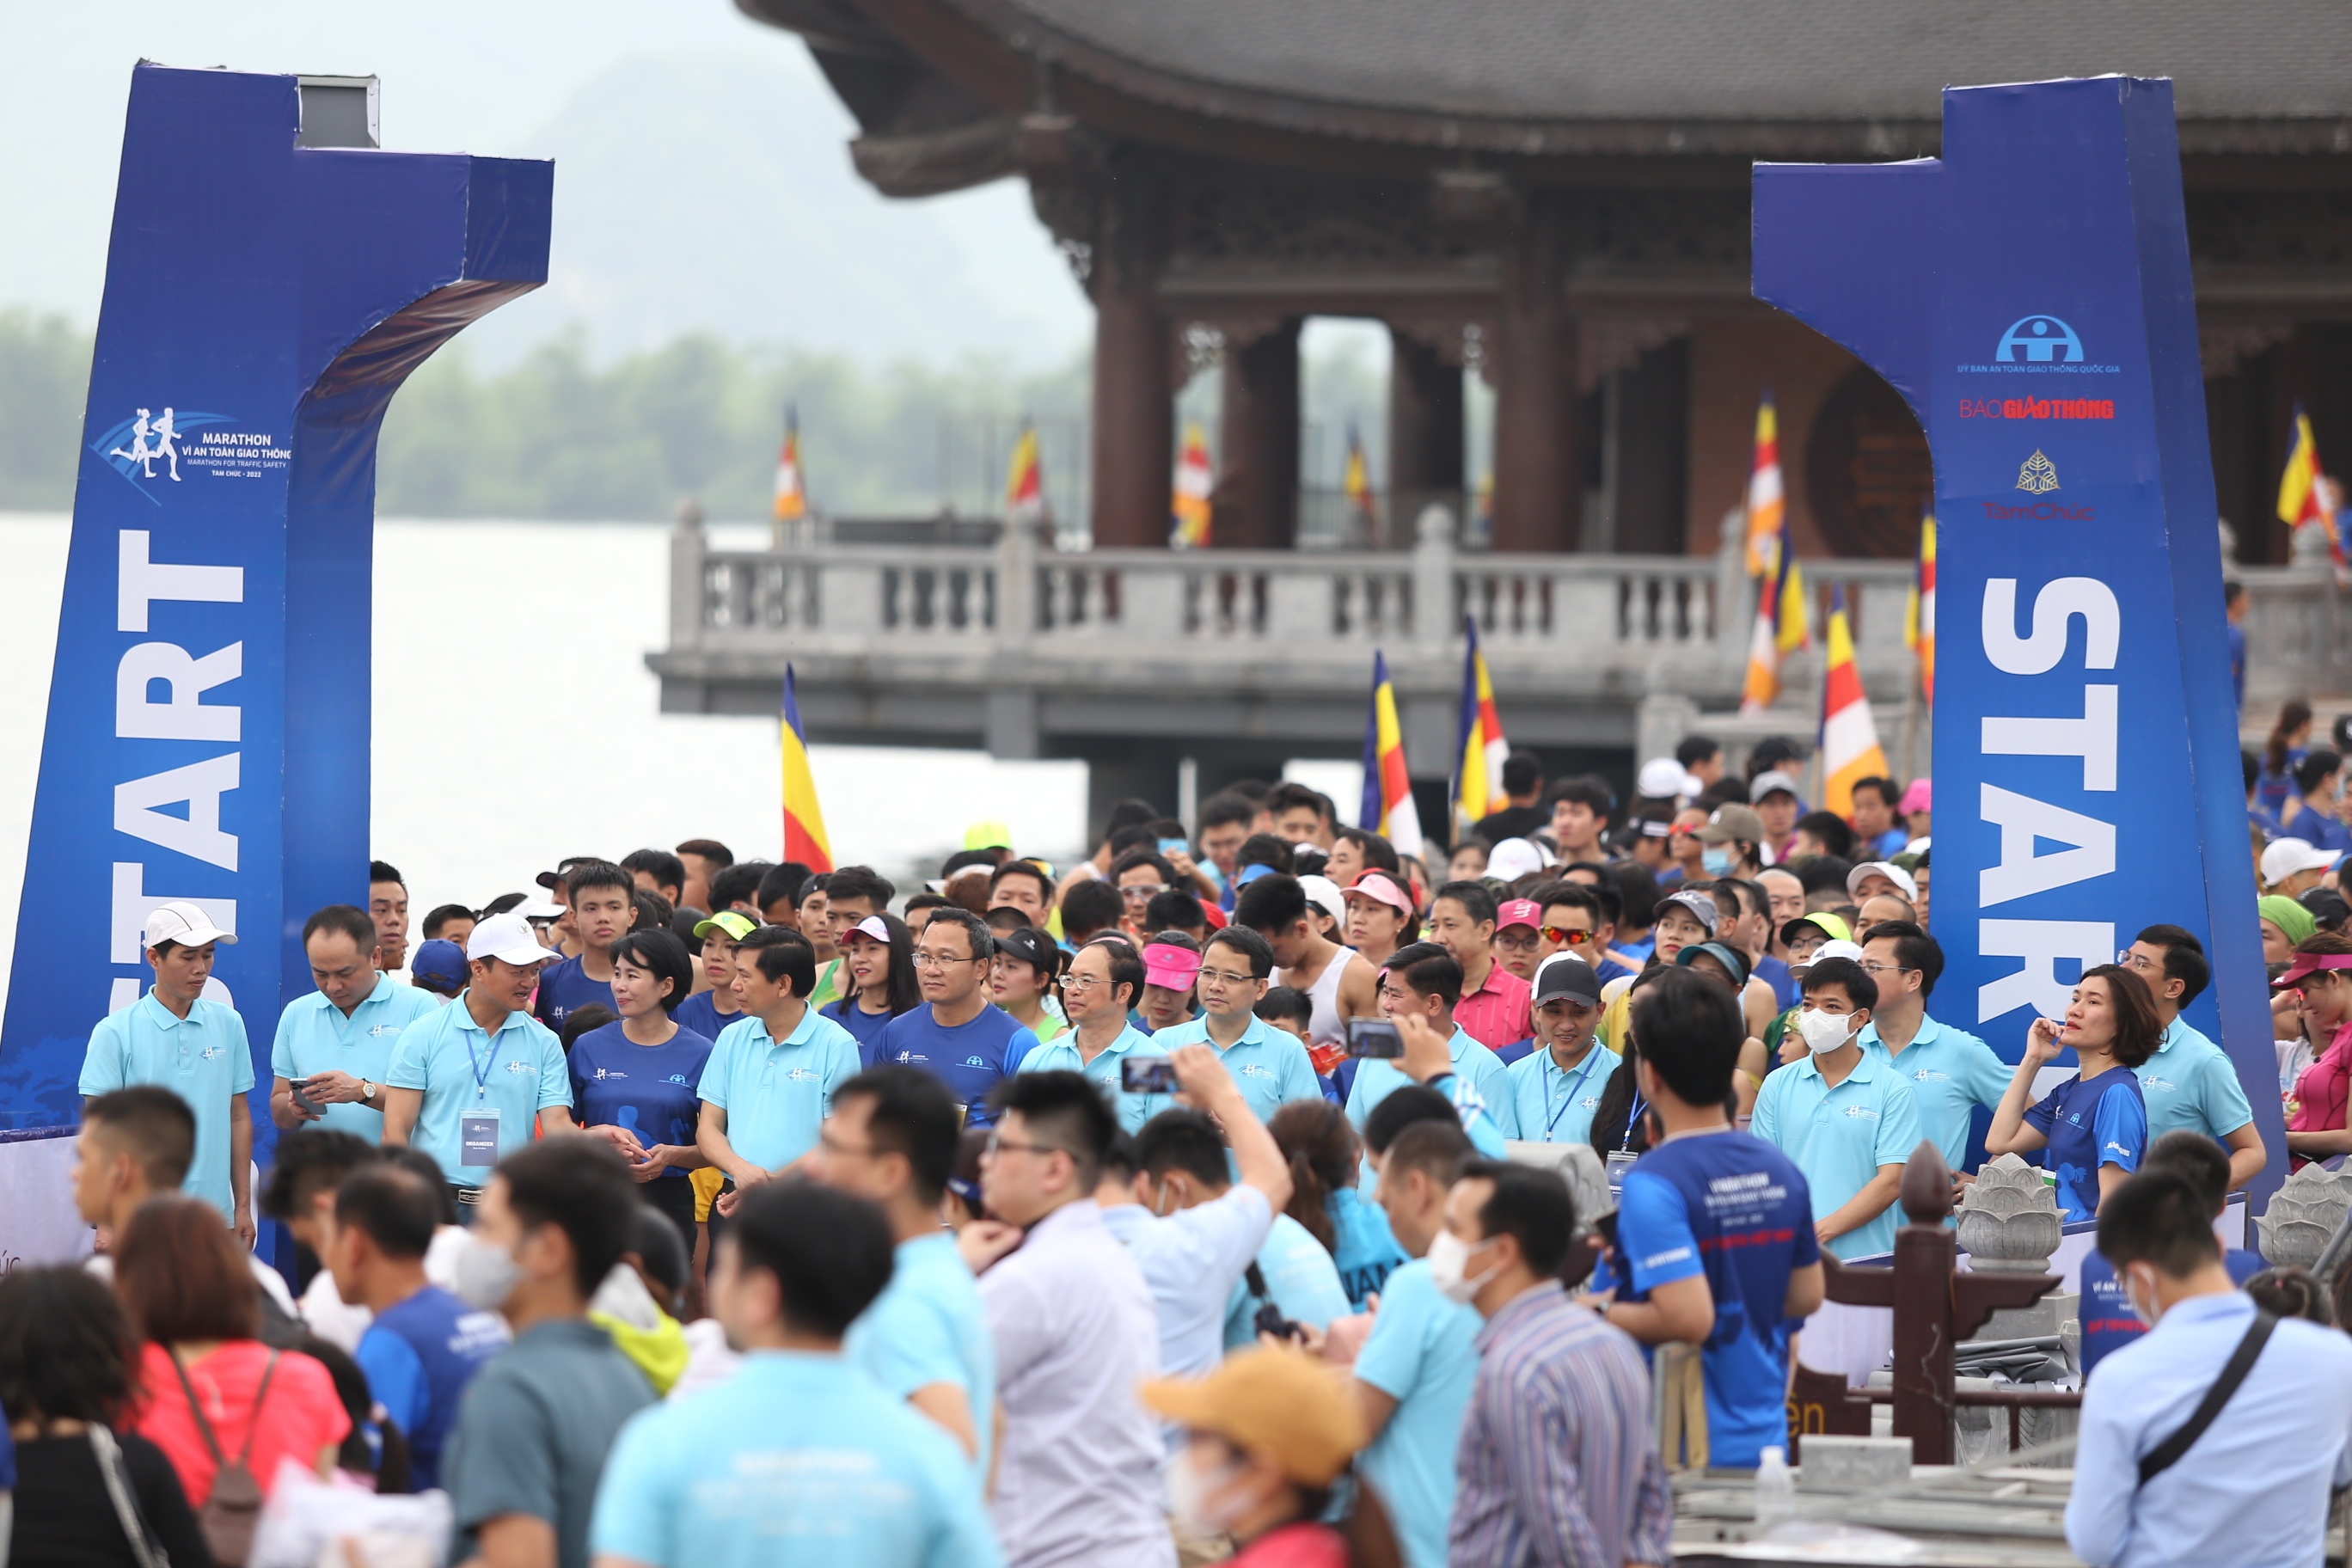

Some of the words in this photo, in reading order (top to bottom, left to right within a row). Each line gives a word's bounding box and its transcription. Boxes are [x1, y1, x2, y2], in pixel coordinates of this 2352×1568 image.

[181, 444, 192, 457] VÌ
[193, 447, 207, 457] AN
[209, 445, 235, 458] TOÀN
[236, 448, 259, 459] GIAO
[202, 432, 272, 446] MARATHON
[108, 530, 244, 1013] TART
[1976, 576, 2121, 1103] STAR
